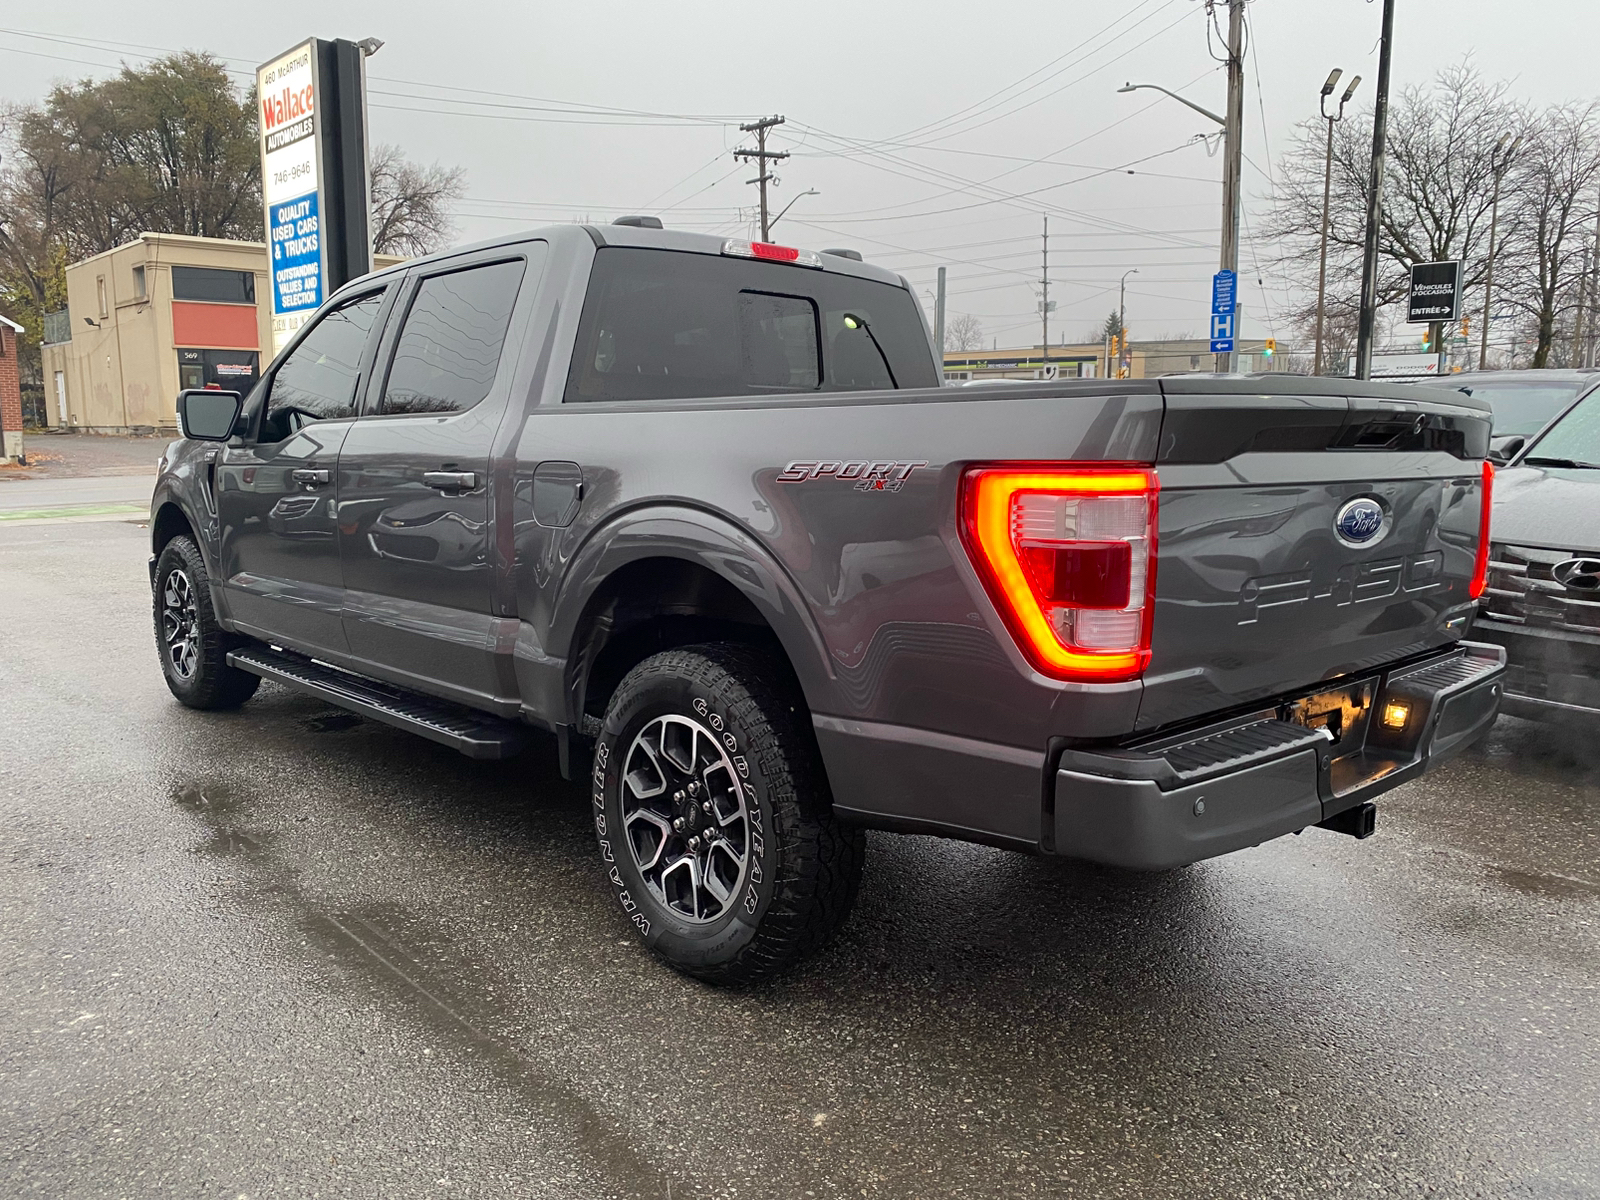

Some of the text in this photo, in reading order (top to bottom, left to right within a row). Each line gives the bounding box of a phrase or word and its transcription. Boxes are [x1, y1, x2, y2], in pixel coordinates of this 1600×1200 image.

[265, 53, 309, 85] 460 McARTHUR
[262, 84, 314, 130] Wallace
[267, 117, 313, 151] AUTOMOBILES
[273, 160, 311, 186] 746-9646
[278, 199, 310, 223] QUALITY
[272, 215, 318, 242] USED CARS
[274, 233, 318, 260] & TRUCKS
[276, 261, 319, 283] OUTSTANDING
[279, 275, 318, 296] VALUES AND
[281, 290, 316, 308] SELECTION
[1411, 306, 1441, 315] ENTRÉE
[1213, 315, 1231, 338] H
[776, 459, 929, 484] SPORT
[1352, 507, 1378, 533] Ford
[1237, 550, 1445, 626] F-150
[692, 697, 765, 915] GOODYEAR
[594, 741, 651, 937] WRANGLER
